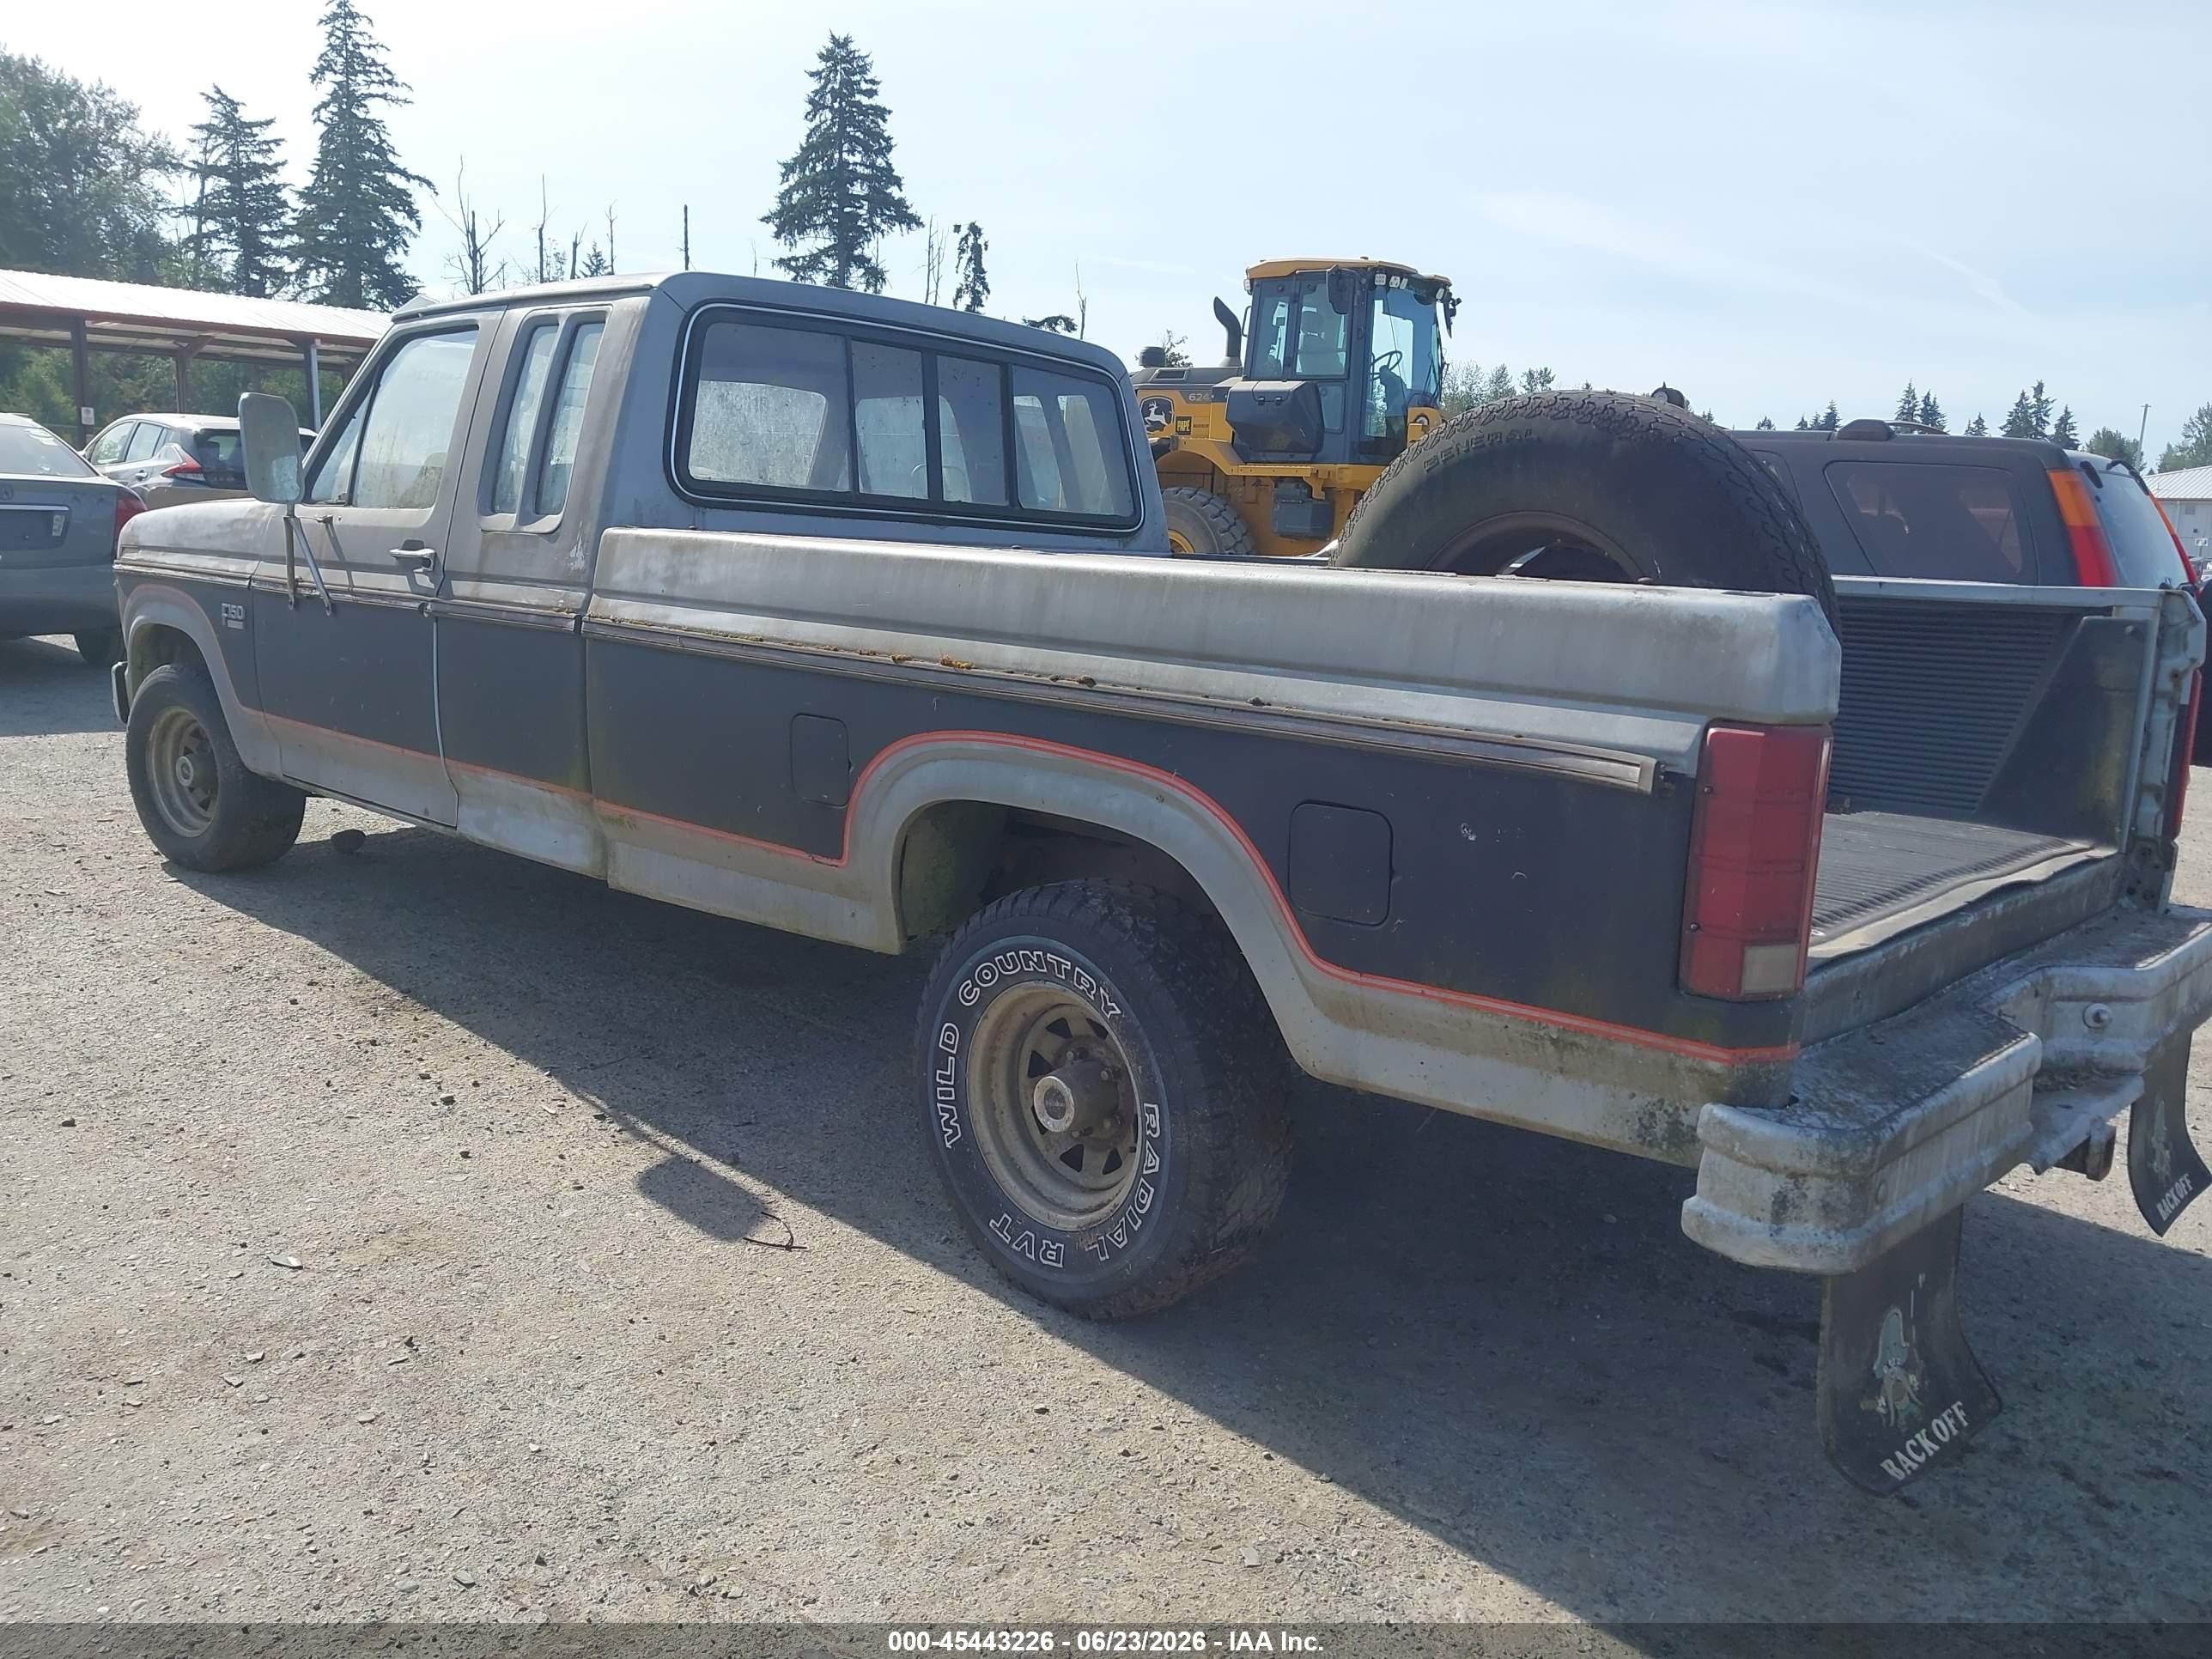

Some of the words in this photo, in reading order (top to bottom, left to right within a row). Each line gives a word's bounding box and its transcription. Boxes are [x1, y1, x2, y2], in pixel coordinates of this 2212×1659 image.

[222, 603, 245, 626] F150
[935, 1022, 961, 1148] WILD
[958, 950, 1121, 1018] COUNTRY
[1085, 1103, 1161, 1262] RADIAL
[2156, 1187, 2181, 1221] BACK
[2174, 1173, 2193, 1199] OFF
[988, 1212, 1066, 1268] RVT
[1880, 1428, 1941, 1481] BACK
[1931, 1401, 1969, 1443] OFF
